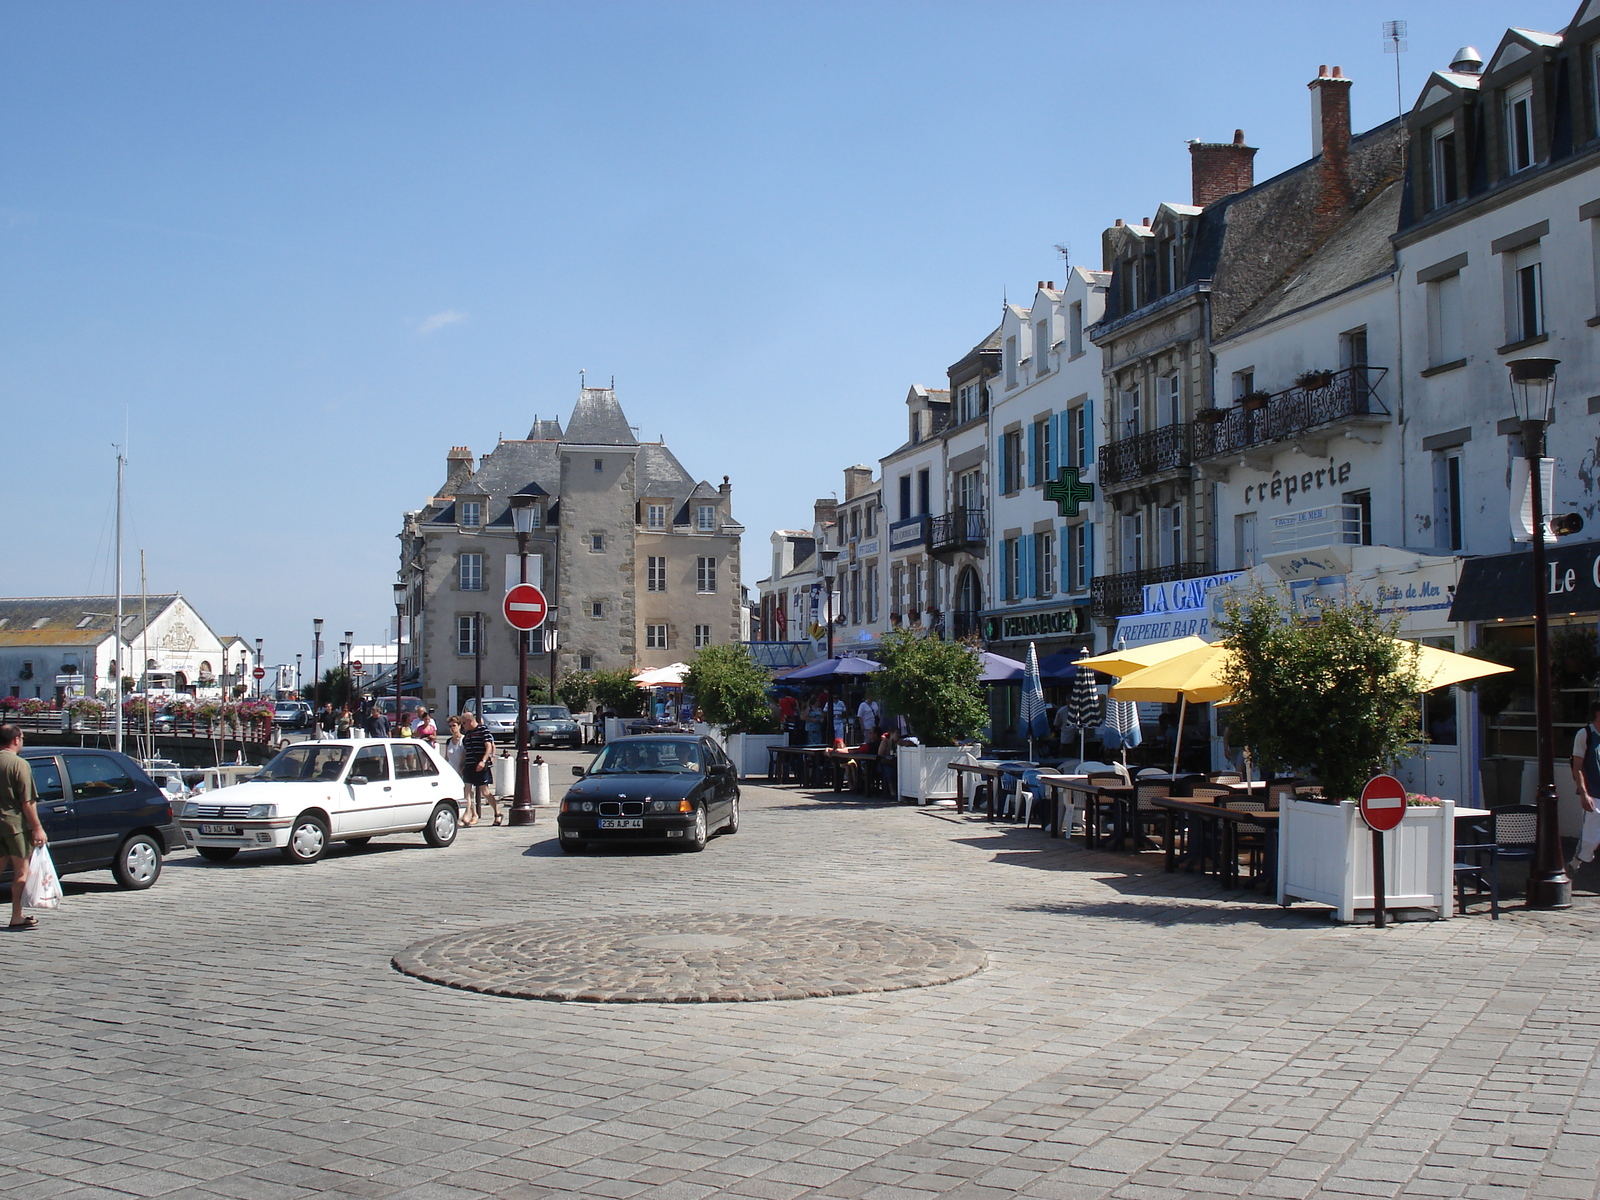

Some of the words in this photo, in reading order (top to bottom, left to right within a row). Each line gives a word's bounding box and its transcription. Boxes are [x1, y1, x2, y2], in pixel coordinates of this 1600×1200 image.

[1244, 456, 1351, 506] crêperie
[1308, 509, 1323, 519] MER
[1405, 583, 1416, 598] de
[1419, 581, 1440, 597] Mer
[1548, 561, 1576, 594] Le
[1142, 585, 1168, 613] LA
[1004, 611, 1068, 637] PHARMACIE
[1117, 622, 1171, 642] CREPERIE
[1172, 619, 1196, 637] BAR
[602, 820, 614, 828] 235
[617, 820, 629, 828] AJP
[632, 820, 641, 828] 44
